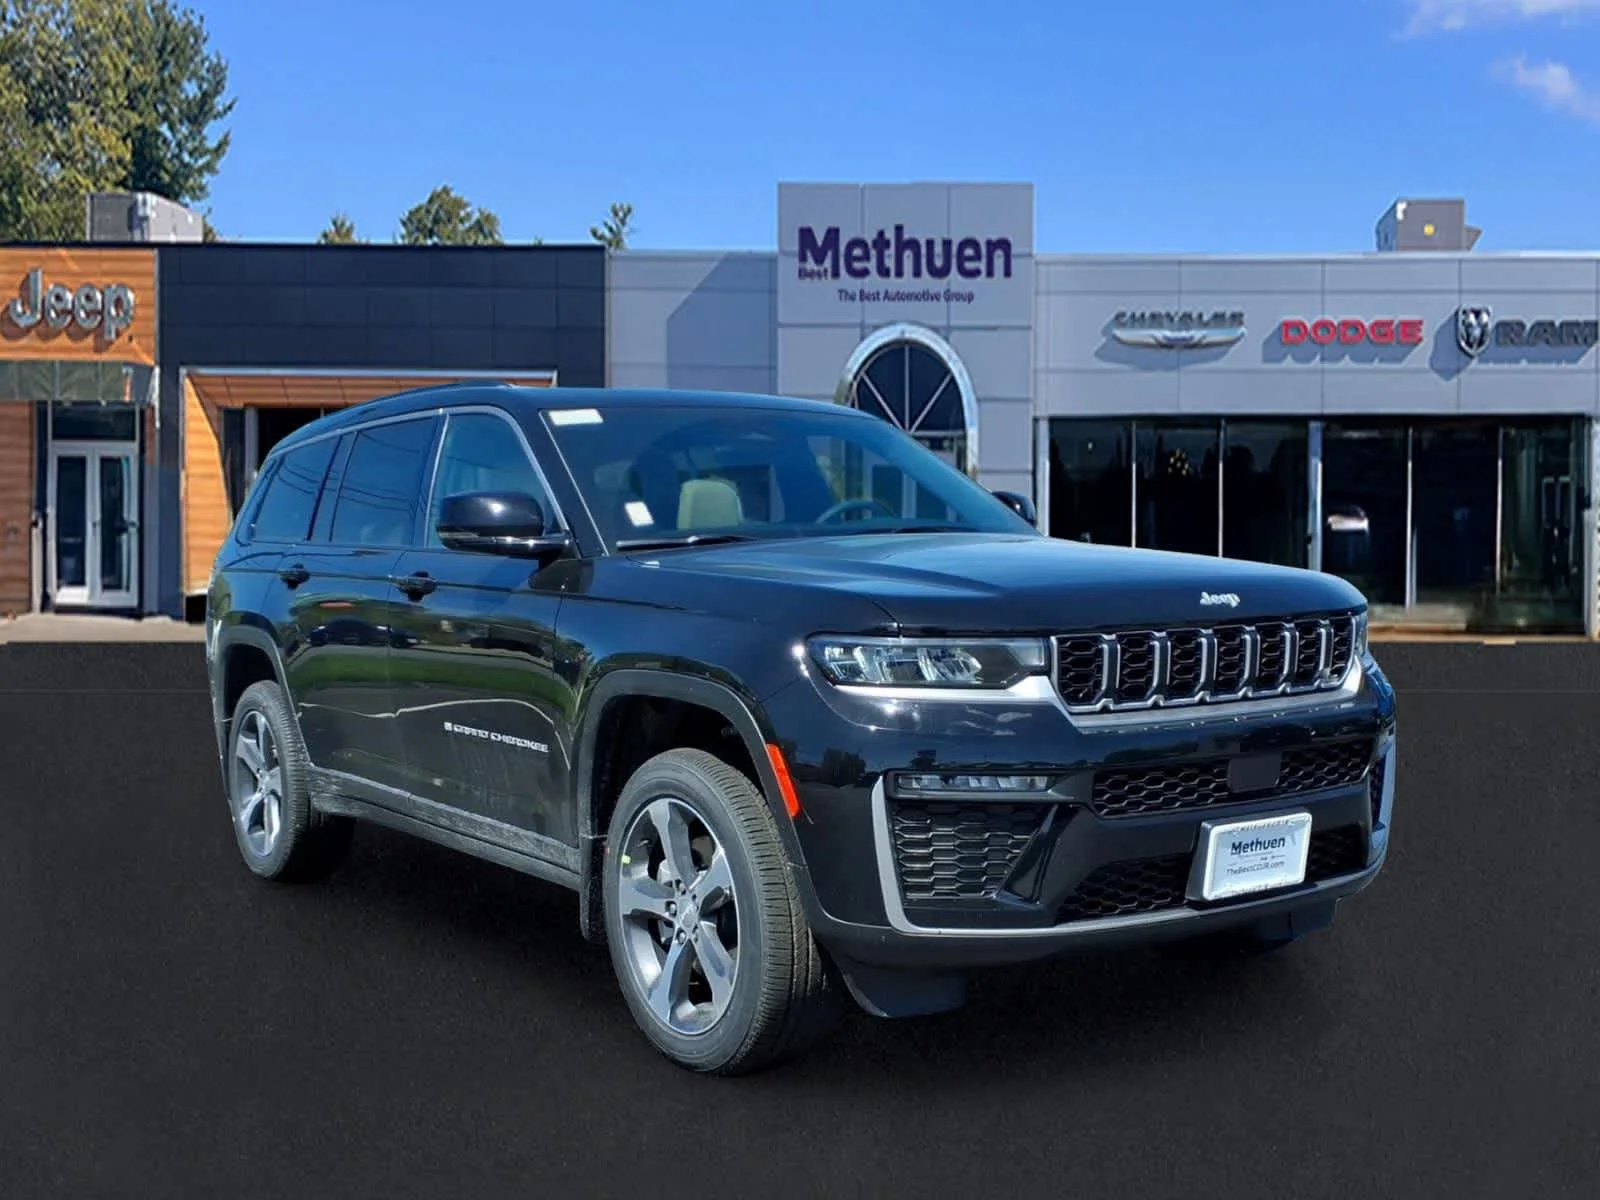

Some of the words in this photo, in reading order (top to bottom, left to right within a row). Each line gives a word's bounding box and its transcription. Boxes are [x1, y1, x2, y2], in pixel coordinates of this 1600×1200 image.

[798, 224, 1012, 279] Methuen
[798, 267, 829, 281] Best
[9, 267, 135, 341] Jeep
[838, 288, 857, 302] The
[859, 288, 880, 302] Best
[882, 288, 941, 302] Automotive
[943, 288, 975, 304] Group
[1113, 311, 1245, 327] CHRYSLER
[1280, 319, 1424, 346] DODGE
[1494, 319, 1599, 346] RAM
[1200, 591, 1240, 608] Jeep
[453, 724, 489, 739] GRAND
[490, 732, 550, 753] CHEROKEE
[1231, 837, 1286, 855] Methuen
